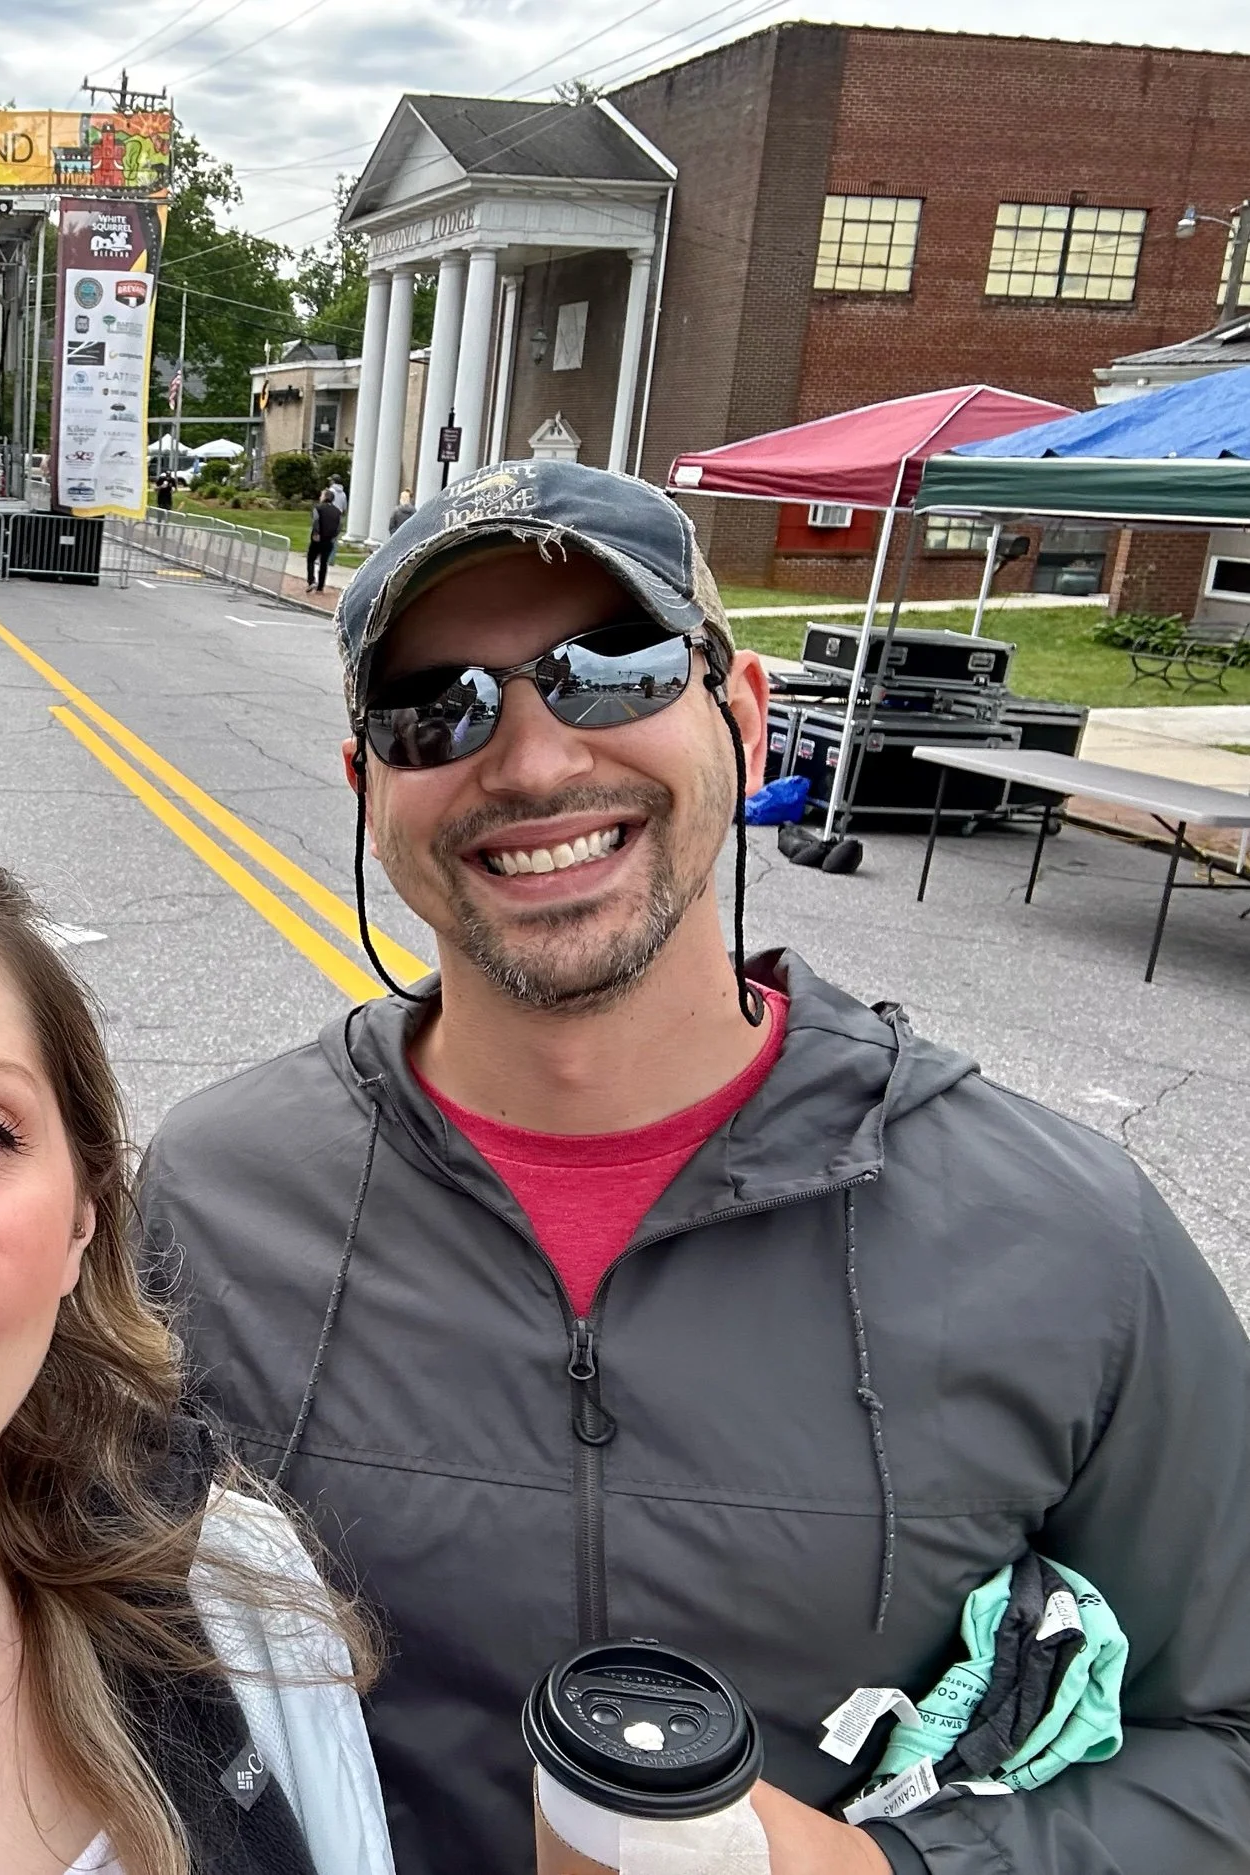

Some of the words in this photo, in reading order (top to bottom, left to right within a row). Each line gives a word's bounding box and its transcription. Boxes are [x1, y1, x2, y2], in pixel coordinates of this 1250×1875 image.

[98, 215, 127, 224] WHITE
[92, 223, 132, 232] SQUIRREL
[373, 224, 422, 256] MASONIC
[432, 207, 476, 238] LODGE
[940, 1719, 962, 1729] STAY
[884, 1785, 917, 1817] CANVAS
